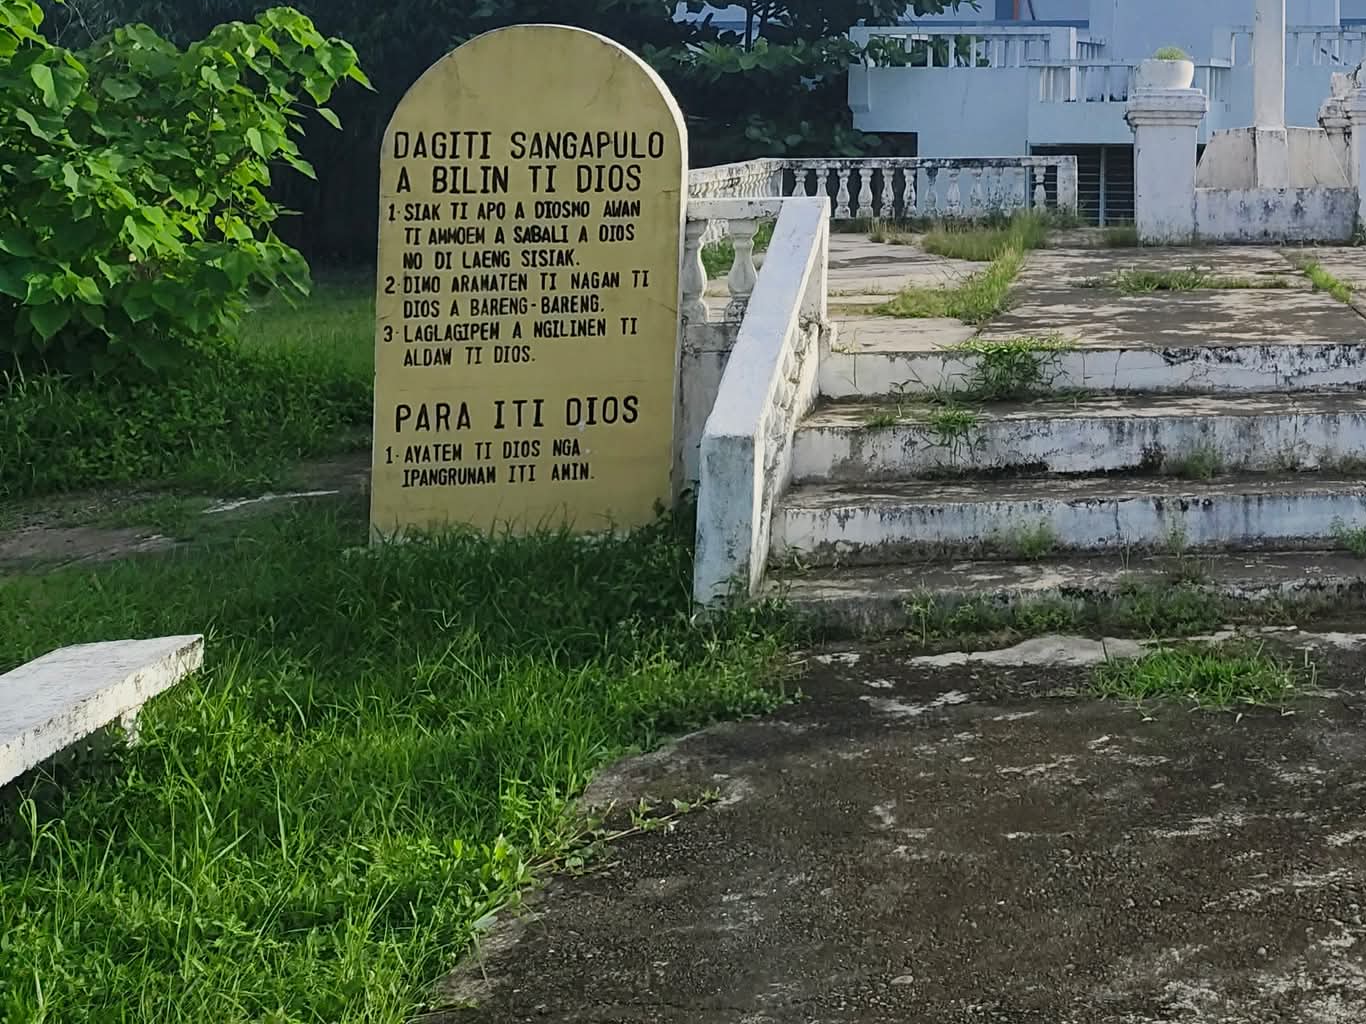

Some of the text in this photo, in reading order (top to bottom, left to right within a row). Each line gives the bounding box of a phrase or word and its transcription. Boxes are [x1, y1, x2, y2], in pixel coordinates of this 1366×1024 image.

[394, 131, 664, 159] DAGITI SANGAPULO
[397, 165, 641, 194] A BILIN TI DIOS
[404, 203, 440, 221] SIAK
[451, 202, 468, 220] TI
[477, 202, 505, 220] APO
[515, 202, 525, 219] A
[603, 200, 640, 217] AWAN
[405, 228, 421, 245] TI
[495, 227, 504, 244] A
[514, 225, 568, 244] SABALI
[579, 226, 588, 243] A
[599, 224, 634, 242] DIOS
[403, 249, 579, 269] NO DI LAENG SISIAK.
[540, 273, 557, 290] TI
[571, 272, 619, 289] NAGAN
[632, 270, 649, 288] TI
[404, 300, 439, 318] DIOS
[450, 300, 459, 316] A
[513, 321, 521, 338] A
[534, 318, 605, 338] NGILINEN
[621, 318, 637, 335] TI
[404, 345, 535, 366] ALDAW TI DIOS.
[396, 396, 638, 432] PARA ITI DIOS
[475, 442, 492, 460] TI
[503, 440, 540, 459] DIOS
[553, 439, 580, 456] NGA
[509, 465, 535, 483] ITI
